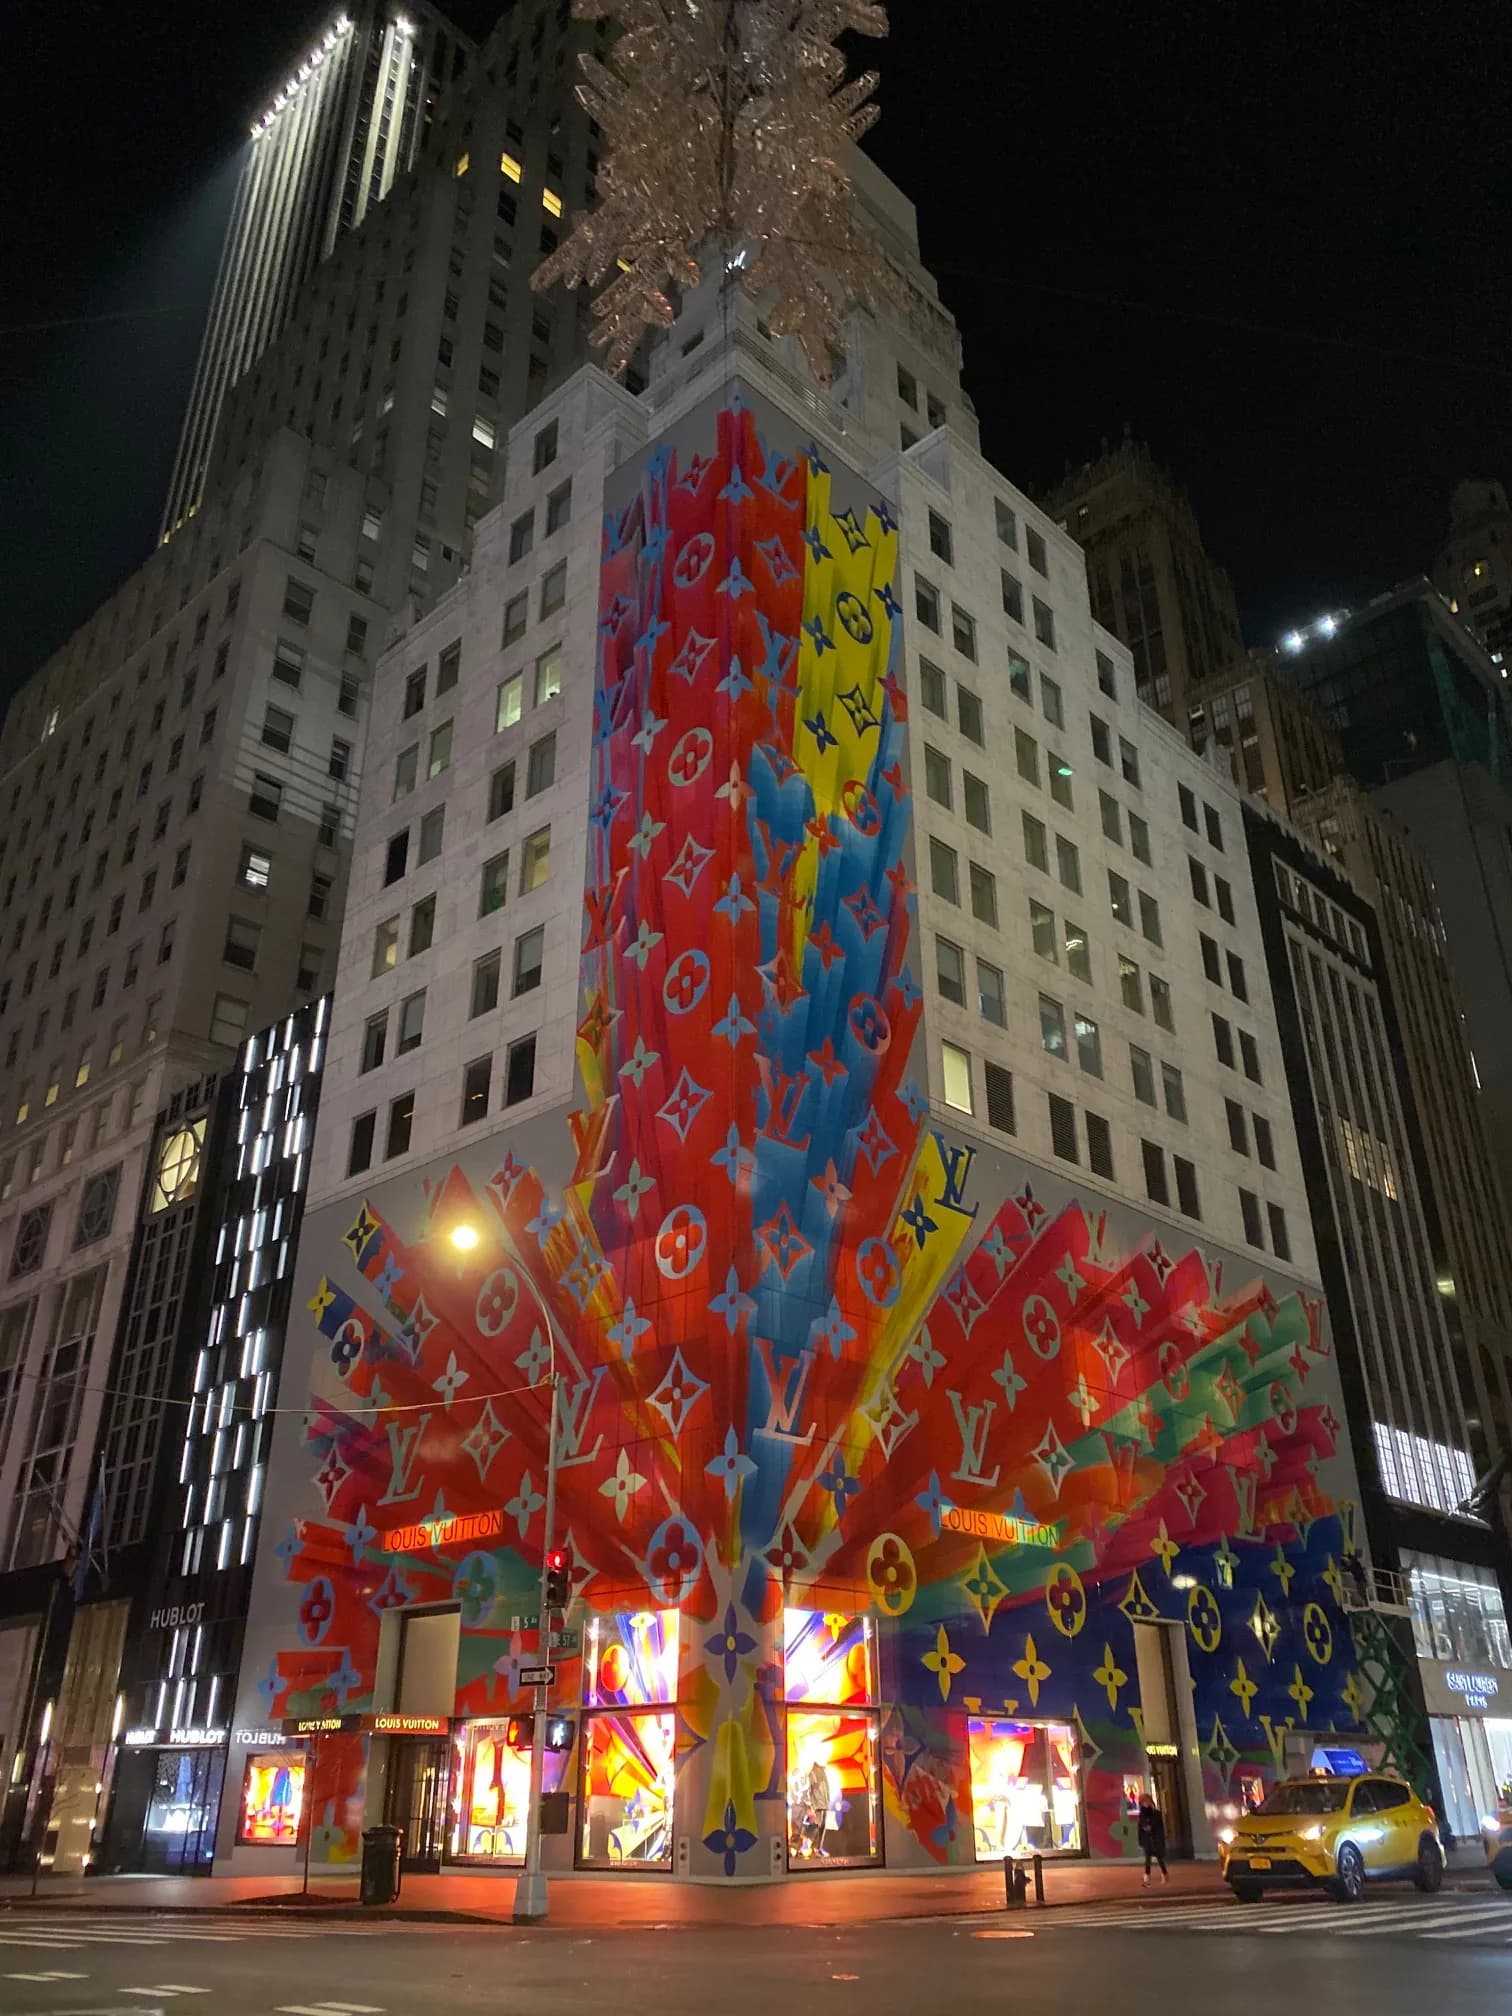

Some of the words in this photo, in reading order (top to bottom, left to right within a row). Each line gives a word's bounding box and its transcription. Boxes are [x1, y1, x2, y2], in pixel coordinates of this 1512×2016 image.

[432, 1511, 502, 1543] VUITTON
[940, 1503, 988, 1535] LOUIS
[992, 1514, 1058, 1547] VUITTON
[151, 1602, 205, 1628] HUBLOT
[170, 1730, 226, 1744] HUBLOT
[375, 1718, 400, 1729] LOUIS
[403, 1719, 439, 1730] VUITTON
